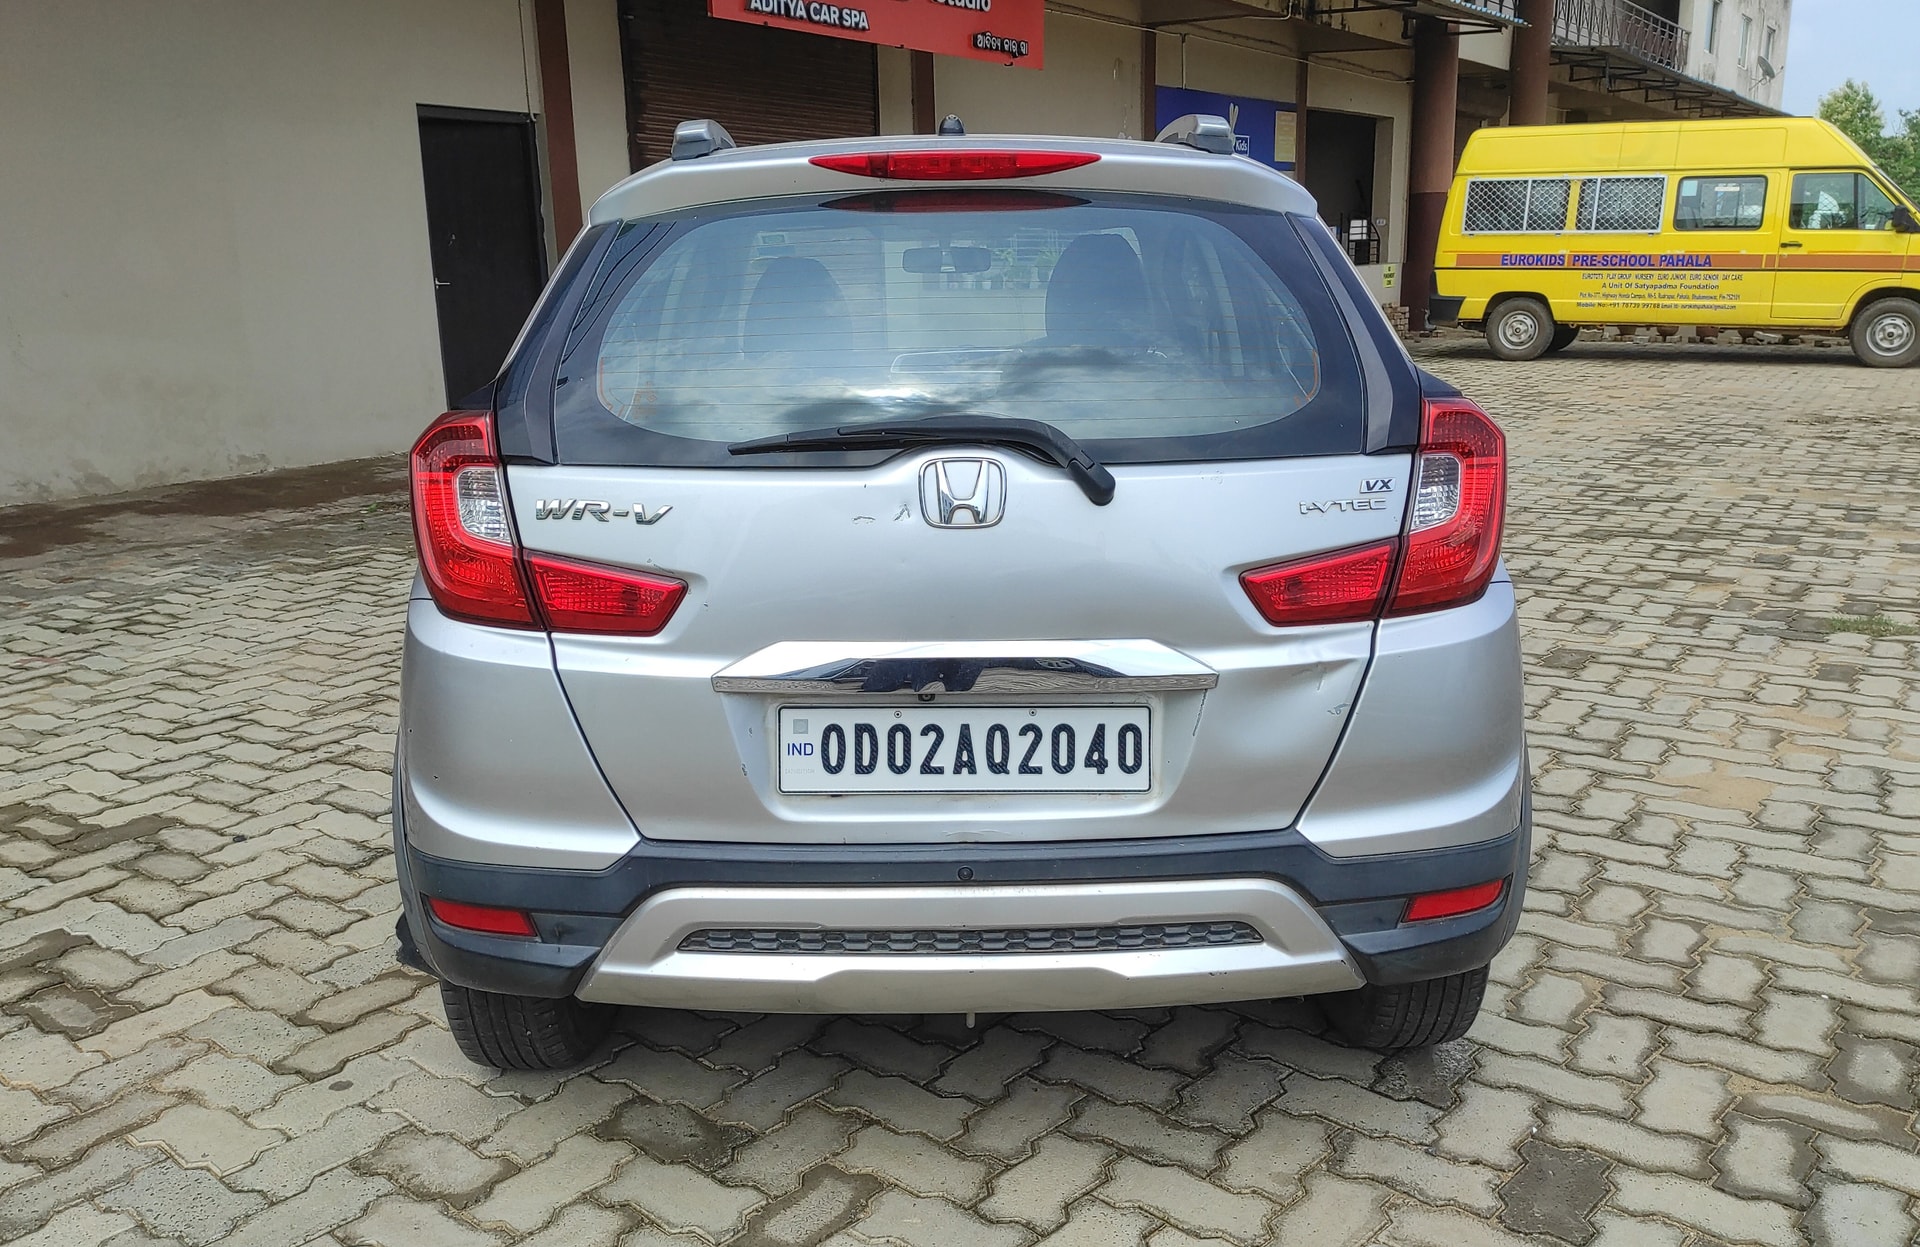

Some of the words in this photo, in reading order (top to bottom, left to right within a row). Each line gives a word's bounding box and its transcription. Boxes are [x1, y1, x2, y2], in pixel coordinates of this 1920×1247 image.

[935, 0, 991, 12] udio
[750, 0, 808, 19] ADITYA
[809, 2, 840, 25] CAR
[842, 8, 869, 30] SPA
[1235, 139, 1248, 151] Kids
[1501, 254, 1566, 267] EUROKIDS
[1572, 254, 1655, 267] PRE-SCHOOL
[1659, 254, 1713, 268] PAHALA
[1365, 478, 1393, 491] VX
[536, 498, 673, 525] WR-V
[1299, 498, 1387, 515] i-VTEC
[787, 742, 814, 757] IND
